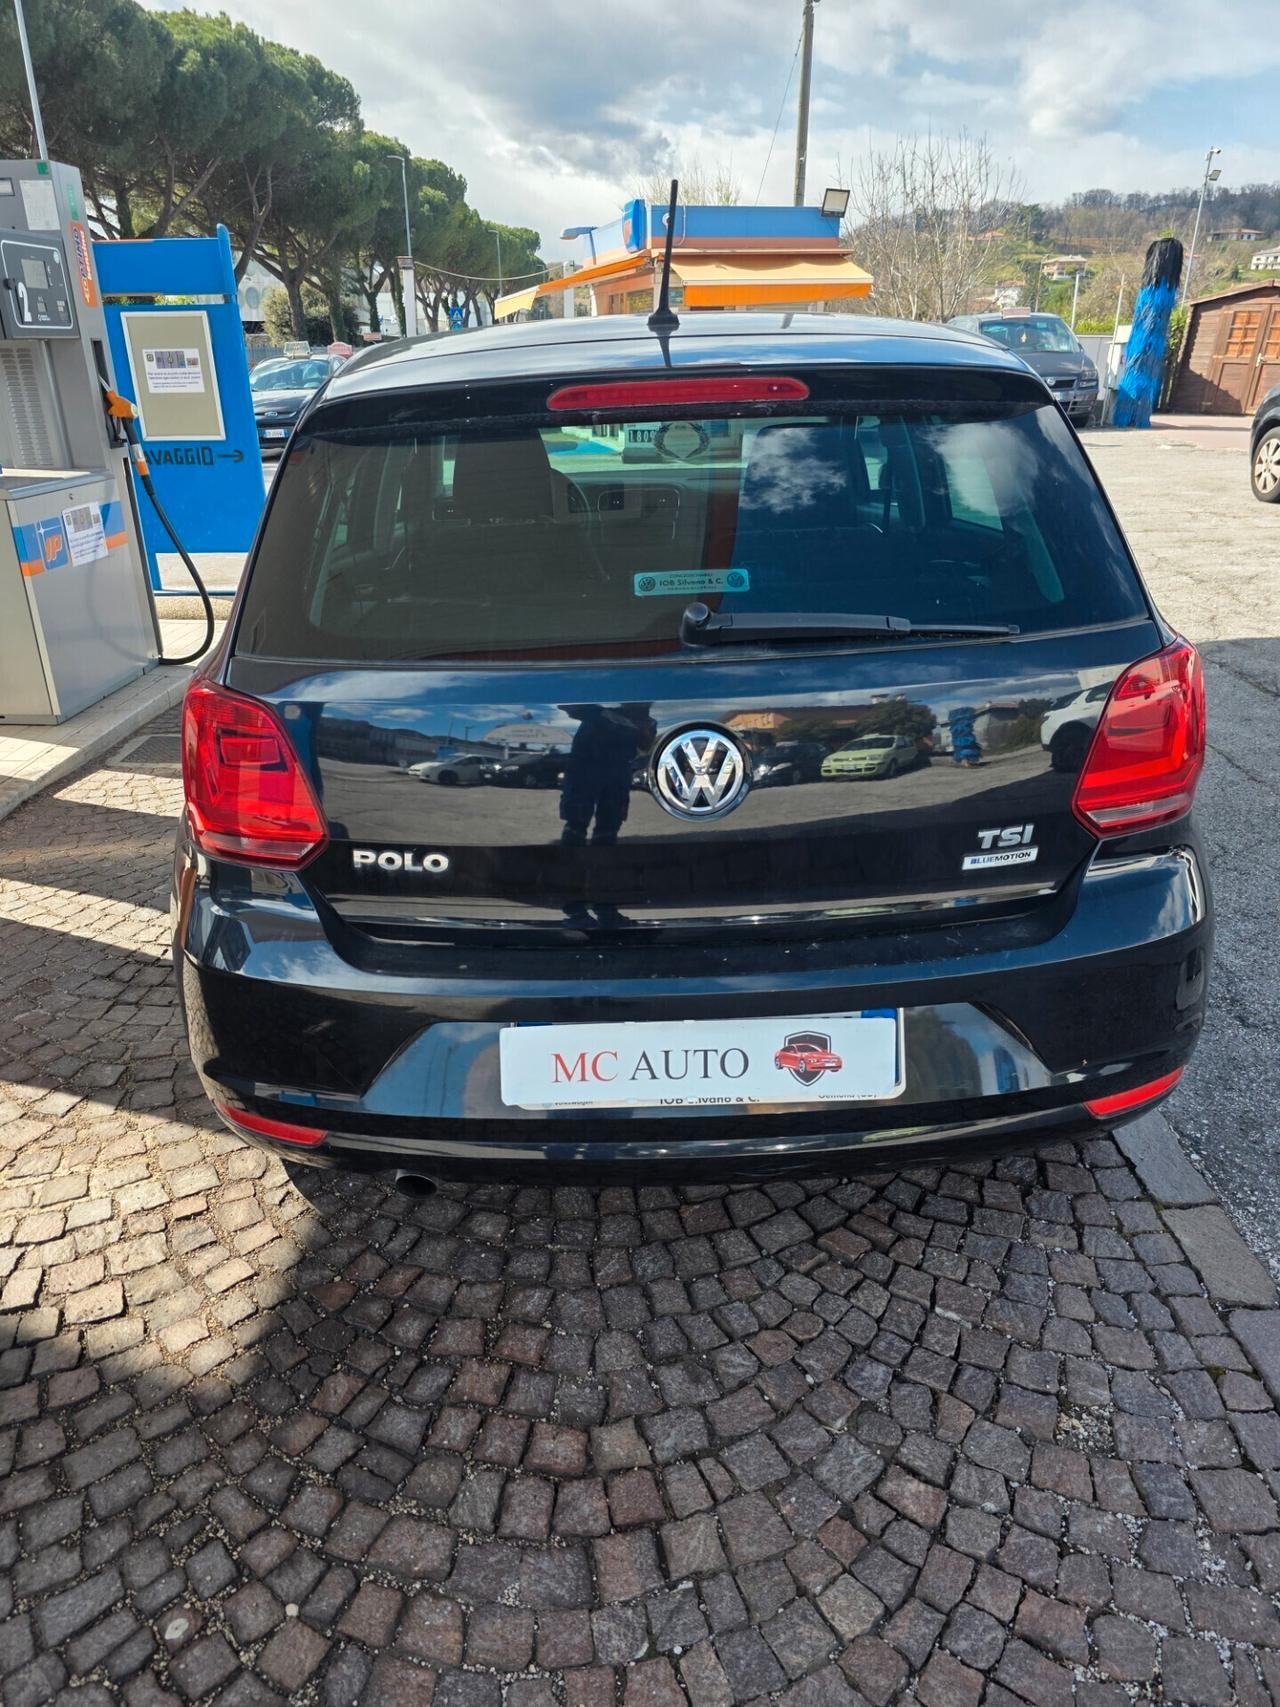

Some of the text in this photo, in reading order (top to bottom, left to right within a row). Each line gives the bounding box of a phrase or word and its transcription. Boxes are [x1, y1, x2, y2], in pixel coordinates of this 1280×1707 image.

[137, 446, 214, 466] AVAGGIO
[977, 824, 1035, 850] TSI
[352, 849, 449, 873] POLO
[970, 851, 1032, 865] BLUEMOTION
[551, 1047, 750, 1084] MC AUTO
